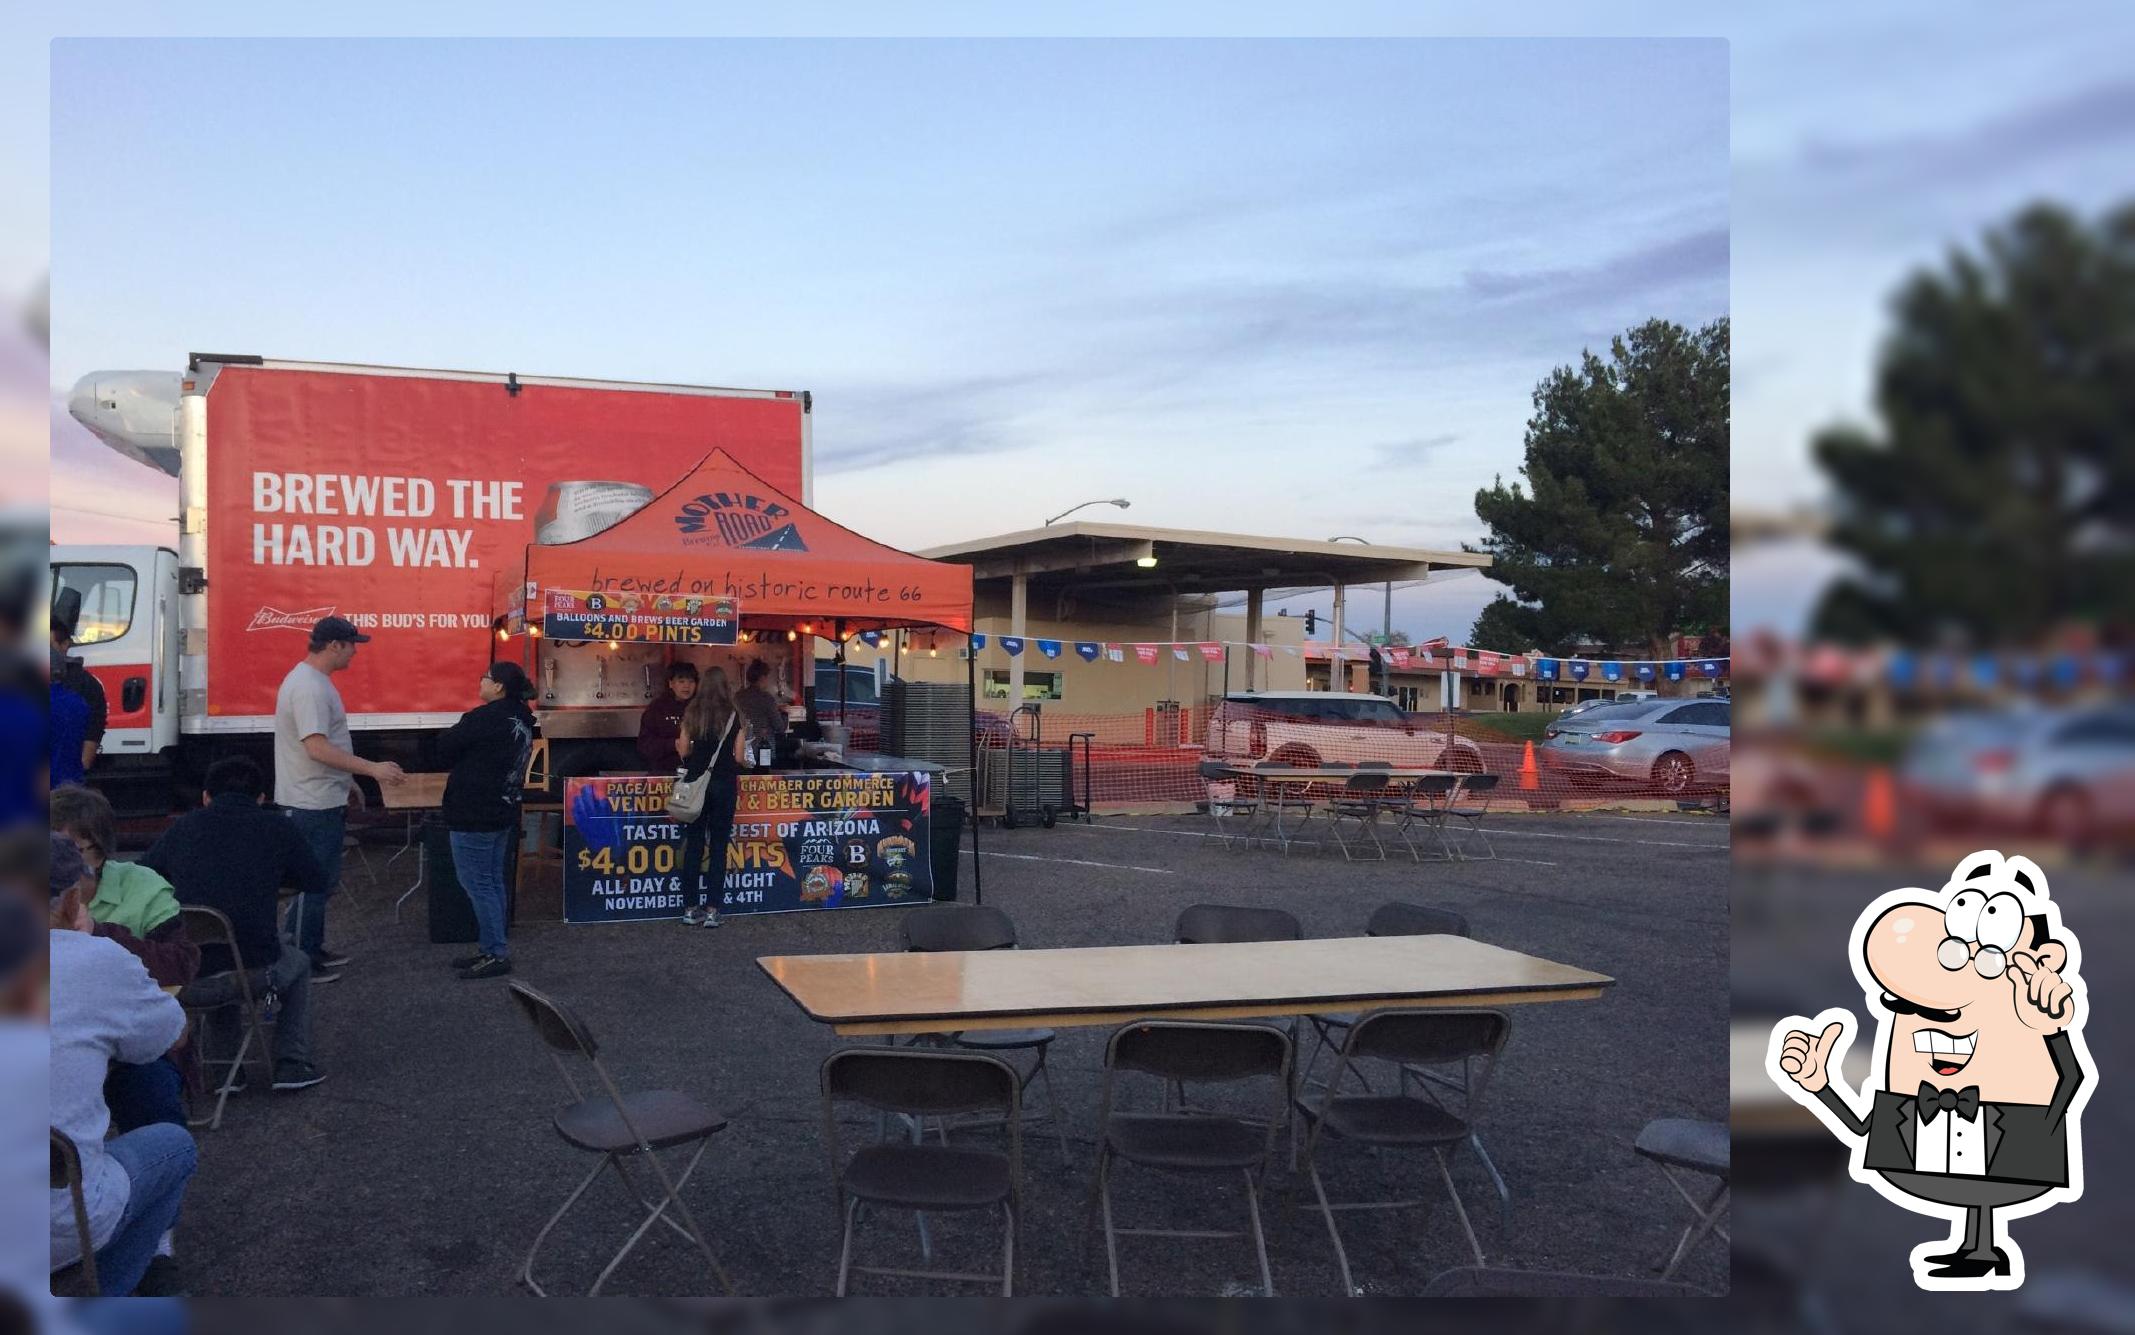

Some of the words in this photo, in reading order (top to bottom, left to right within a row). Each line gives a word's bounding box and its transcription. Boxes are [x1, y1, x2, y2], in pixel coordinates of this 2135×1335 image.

[253, 471, 436, 518] BREWED
[446, 479, 524, 520] THE
[674, 492, 789, 533] MOTHER
[715, 511, 772, 546] ROAD
[253, 523, 376, 566] HARD
[387, 527, 479, 568] WAY.
[592, 567, 684, 594] brewed
[690, 577, 714, 596] on
[725, 571, 818, 600] historic
[827, 576, 890, 603] route
[900, 585, 922, 601] 66
[344, 613, 378, 628] THIS
[381, 613, 425, 628] BUD'S
[429, 613, 458, 628] FOR
[556, 612, 606, 623] BALLOONS
[608, 614, 628, 624] AND
[631, 614, 663, 625] BREWS
[665, 616, 688, 625] BEER
[690, 617, 727, 628] GARDEN
[584, 622, 638, 640] $4.00
[646, 625, 702, 642] PINTS
[607, 783, 674, 795] PAGE/LAK
[740, 779, 803, 792] CHAMBER
[806, 779, 824, 791] OF
[826, 778, 894, 790] COMMERCE
[748, 794, 760, 810] &
[766, 792, 814, 810] BEER
[820, 790, 894, 809] GARDEN
[623, 824, 681, 841] TASTE
[776, 822, 799, 838] OF
[803, 819, 881, 837] ARIZONA
[578, 845, 675, 875] $4.00
[800, 845, 834, 855] FOUR
[800, 854, 834, 863] PEAKS
[591, 878, 624, 896] ALL
[629, 876, 666, 894] DAY
[669, 876, 682, 892] &
[723, 872, 776, 889] NIGHT
[605, 895, 684, 911] NOVEMBER
[723, 892, 733, 905] &
[736, 890, 763, 904] 4TH
